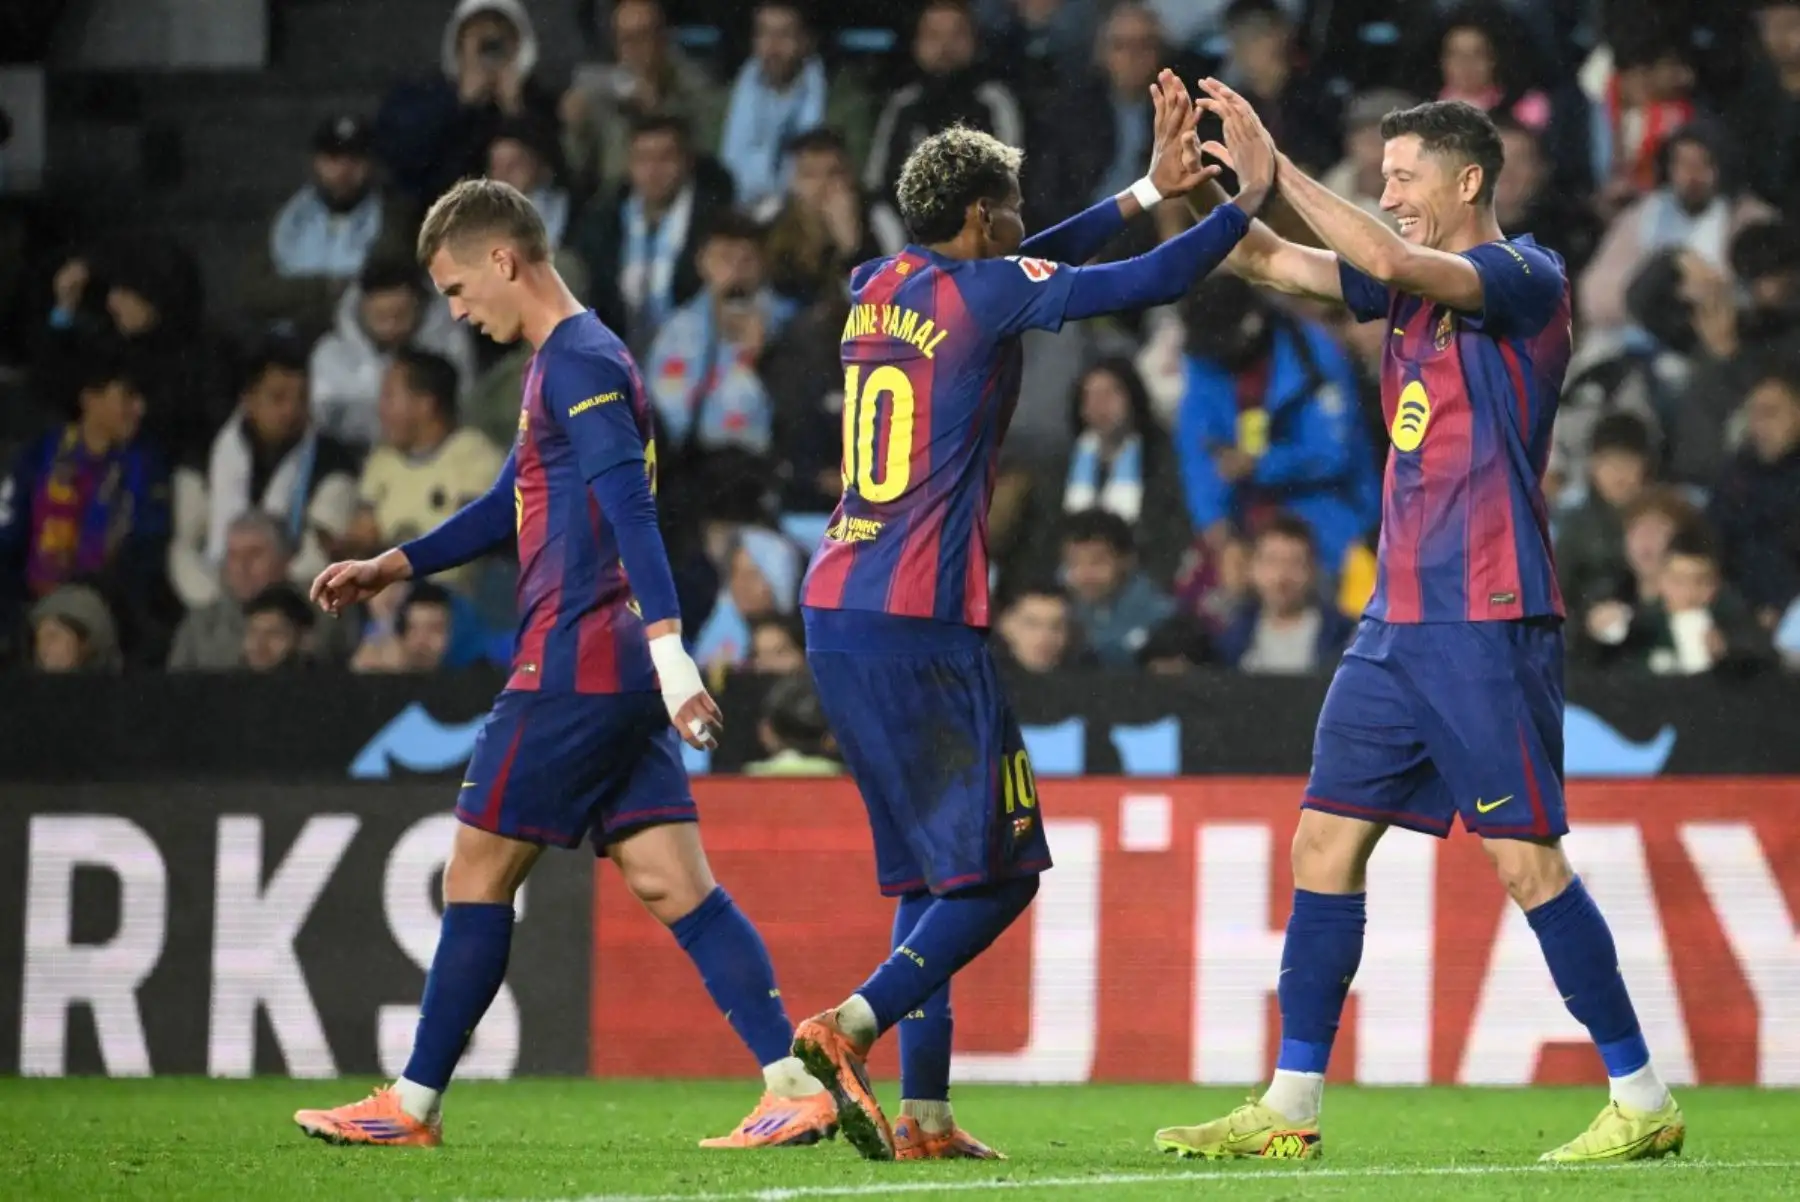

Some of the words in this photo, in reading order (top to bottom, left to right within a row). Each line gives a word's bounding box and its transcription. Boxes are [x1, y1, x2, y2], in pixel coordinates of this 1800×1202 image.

[881, 303, 948, 360] YAMAL
[842, 364, 914, 504] 10
[848, 516, 886, 535] UNHC
[1002, 749, 1035, 814] 10
[20, 812, 522, 1080] RKS
